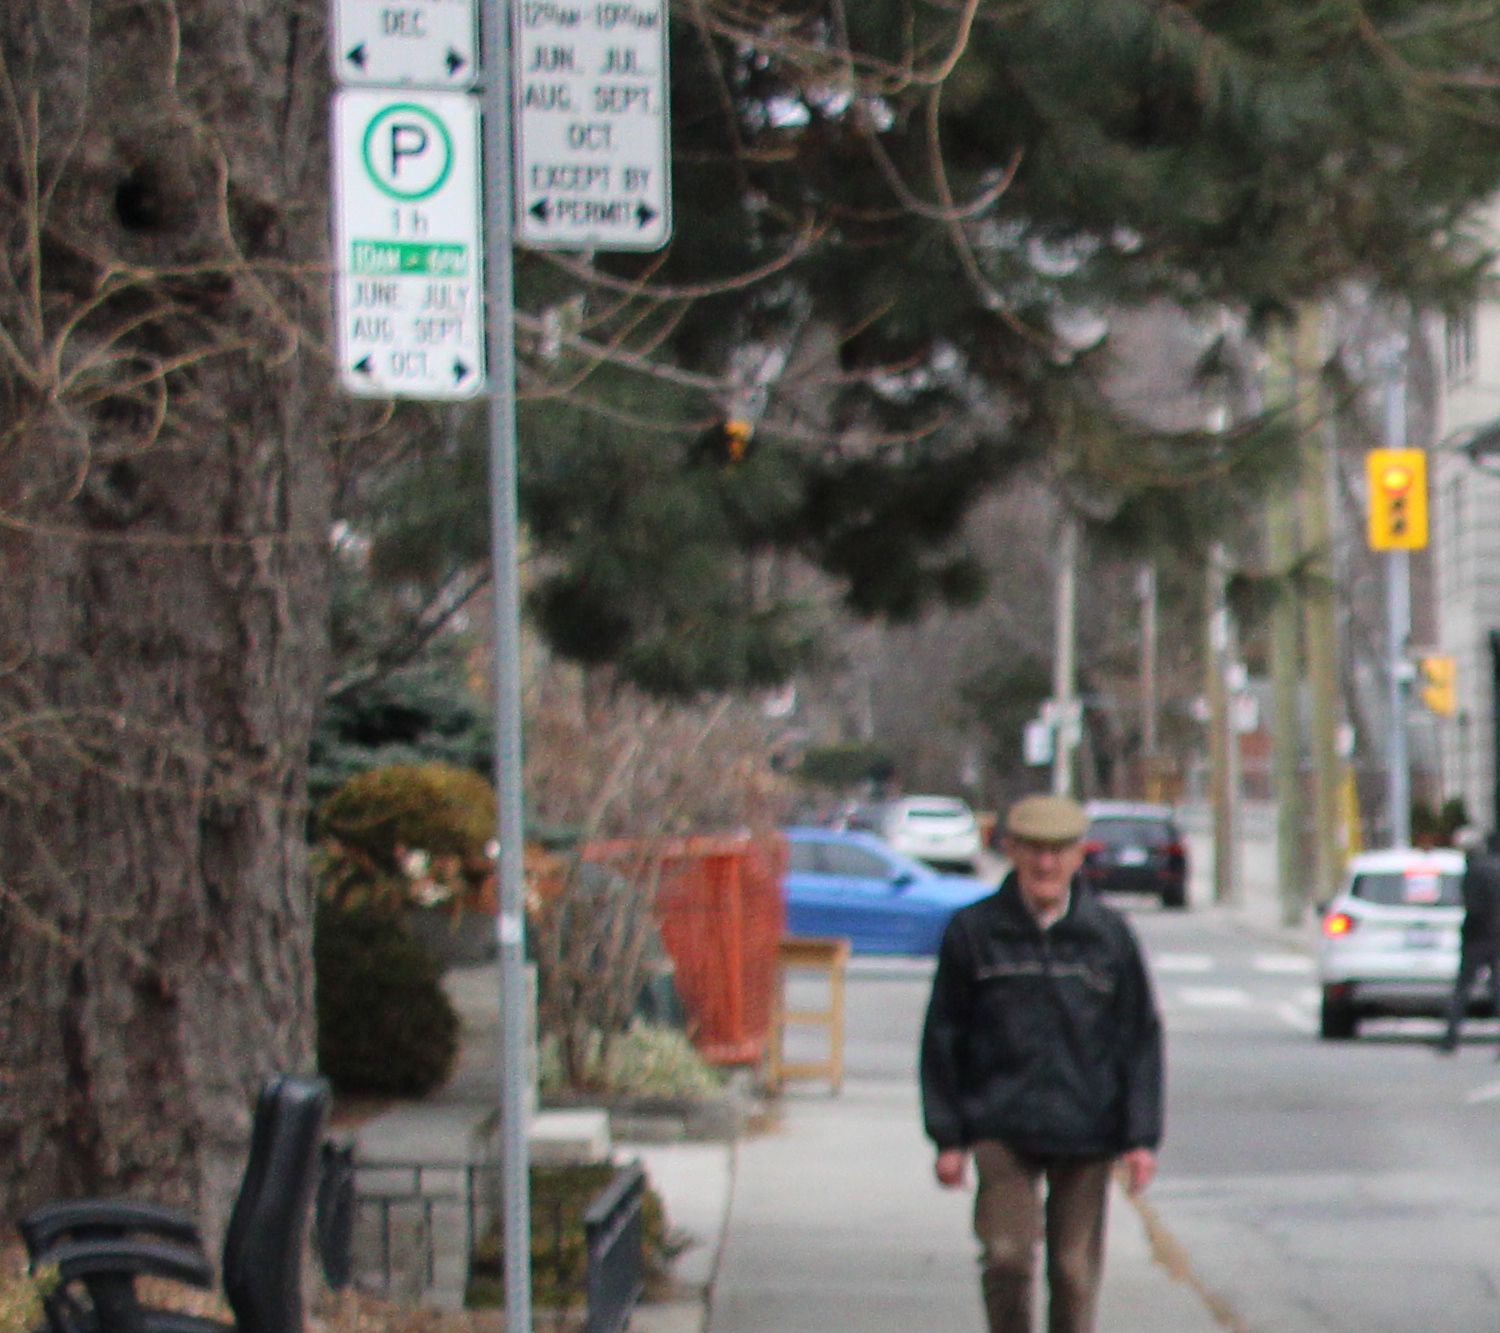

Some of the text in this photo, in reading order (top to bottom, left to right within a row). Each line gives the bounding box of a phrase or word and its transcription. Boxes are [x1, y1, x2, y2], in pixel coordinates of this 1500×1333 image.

[390, 123, 429, 178] P
[530, 163, 650, 191] EXCEPT BY
[555, 198, 631, 224] PERMIT
[353, 281, 470, 311] JUNE JULY
